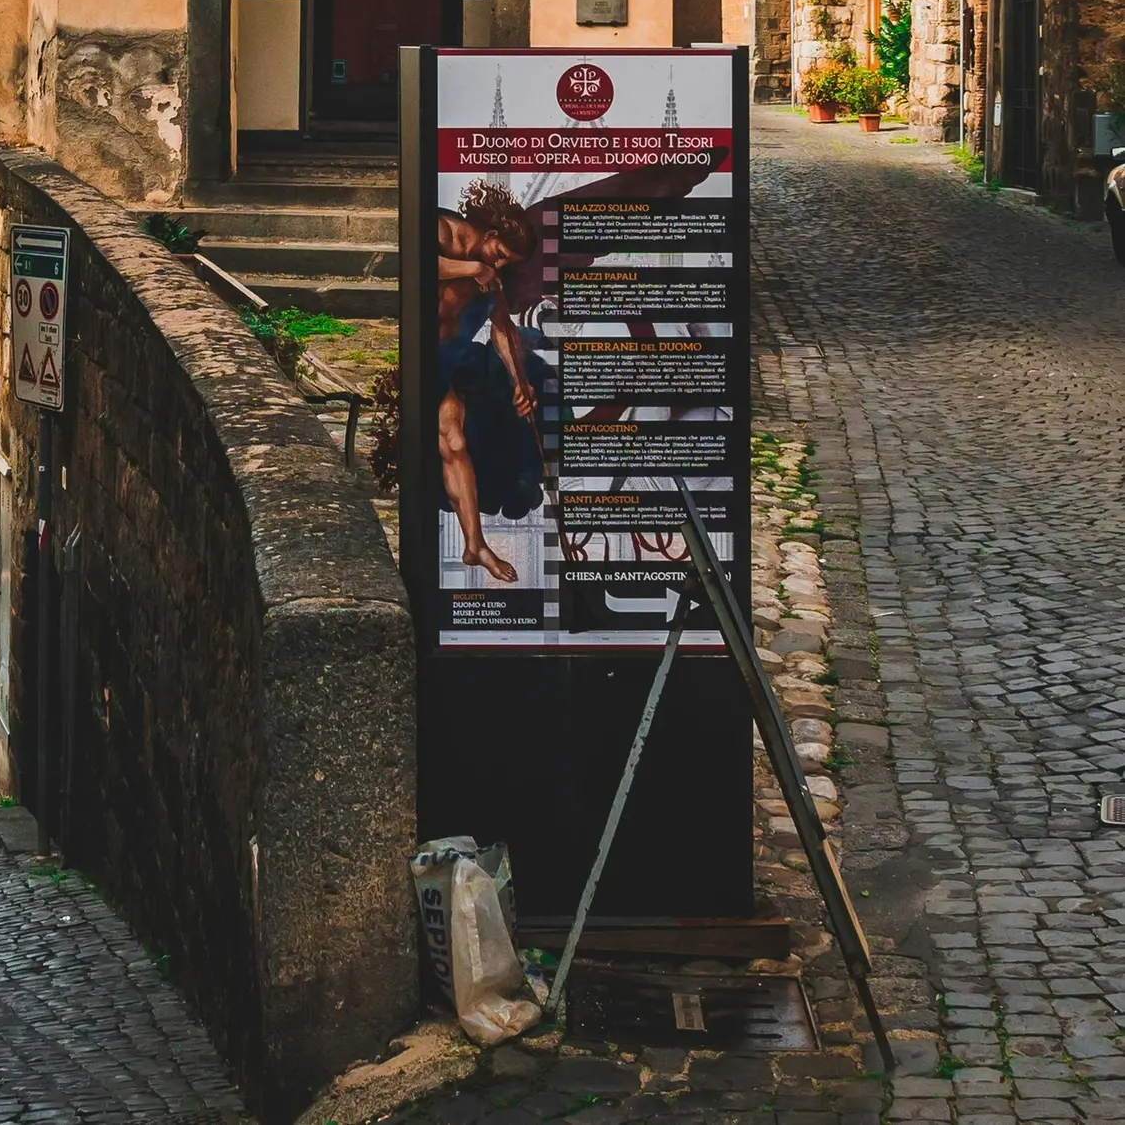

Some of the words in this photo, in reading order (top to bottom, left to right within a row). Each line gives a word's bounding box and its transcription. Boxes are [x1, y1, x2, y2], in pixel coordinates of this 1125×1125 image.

[457, 138, 468, 148] IL
[531, 138, 544, 148] DI
[612, 138, 620, 148] E
[624, 138, 628, 148] I
[631, 138, 662, 148] SUOI
[460, 153, 507, 164] MUSEO
[510, 152, 581, 164] DELL'OPERA
[584, 156, 602, 164] DEL
[605, 153, 658, 164] DUOMO
[660, 152, 711, 166] (MODO)
[54, 262, 59, 275] 6
[18, 289, 28, 306] 30
[564, 342, 639, 351] SOTTERRANEI
[659, 342, 702, 351] DUOMO
[565, 572, 602, 581] CHIESA
[614, 572, 687, 581] SANT'AGOSTIN
